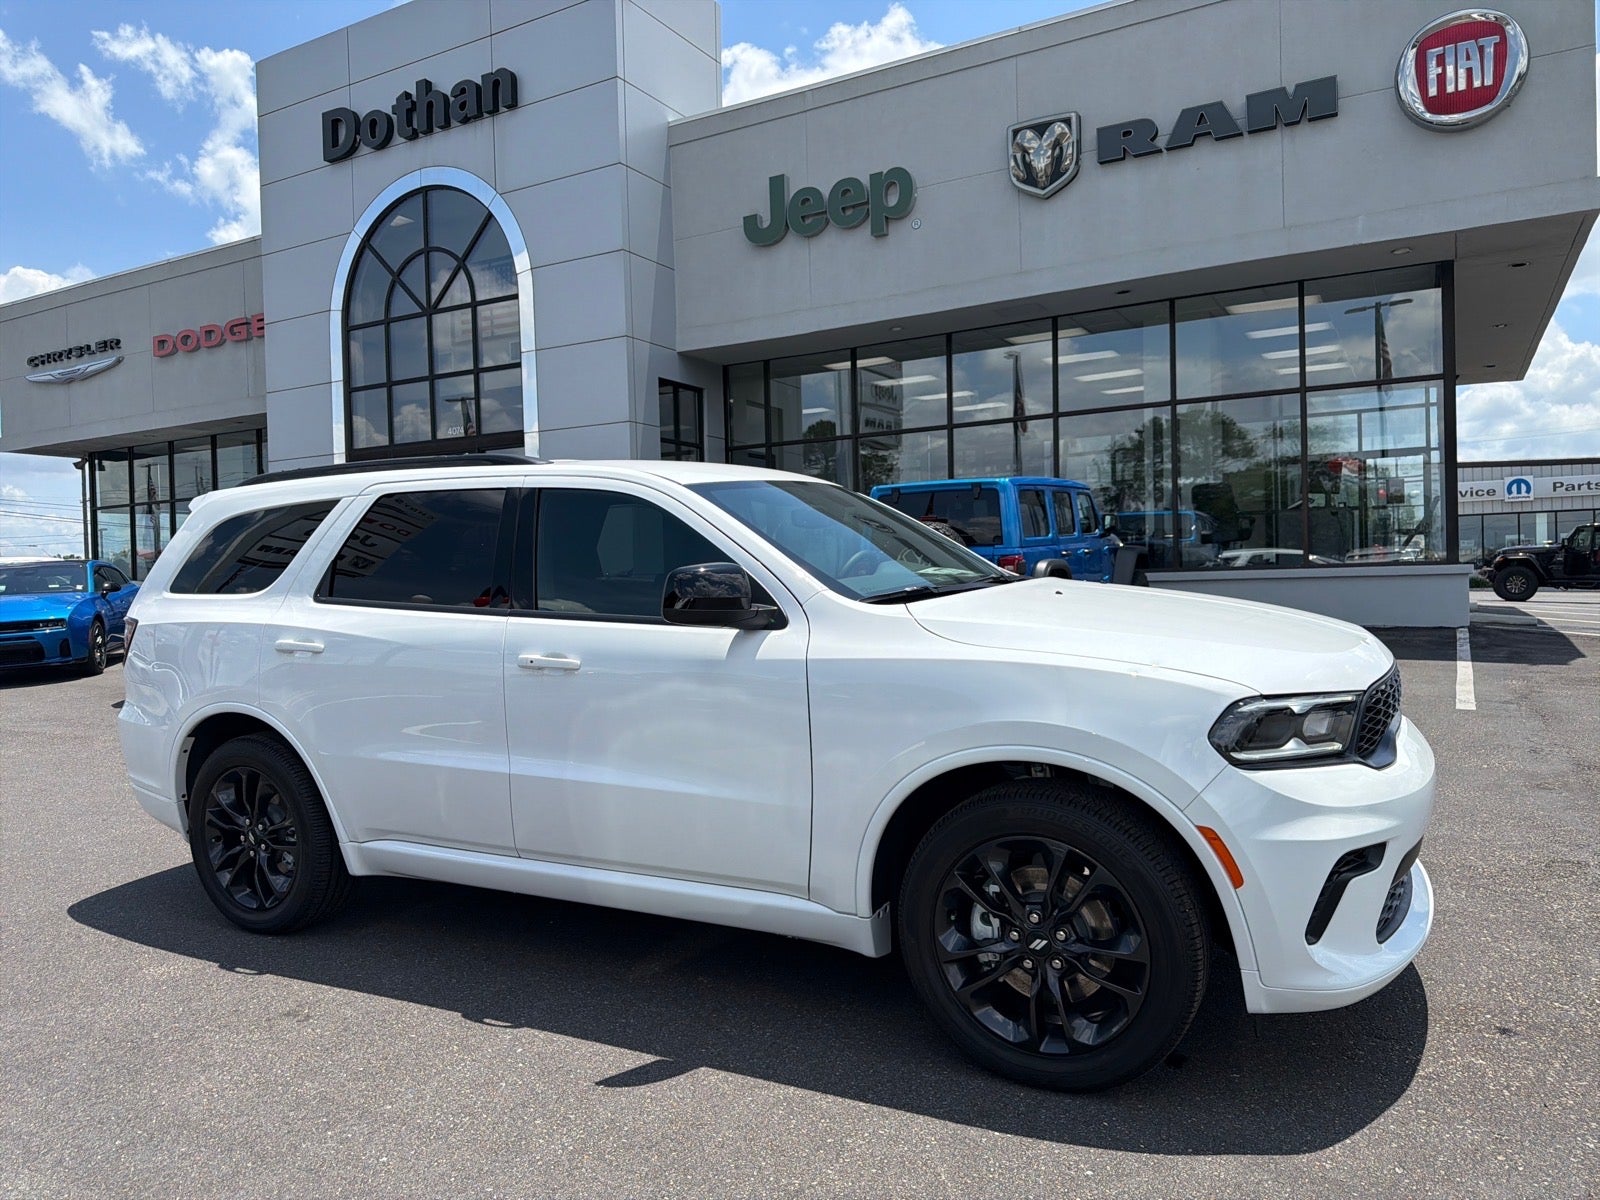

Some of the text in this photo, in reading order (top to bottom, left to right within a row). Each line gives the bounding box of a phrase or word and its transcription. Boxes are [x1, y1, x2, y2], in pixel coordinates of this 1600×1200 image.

[1425, 35, 1500, 98] FIAT
[321, 67, 519, 163] Dothan
[1096, 74, 1338, 165] RAM
[742, 166, 917, 247] Jeep
[26, 337, 122, 368] CHRYSLER
[152, 312, 265, 358] DODGE
[447, 424, 465, 435] 4074
[1552, 480, 1600, 492] Parts
